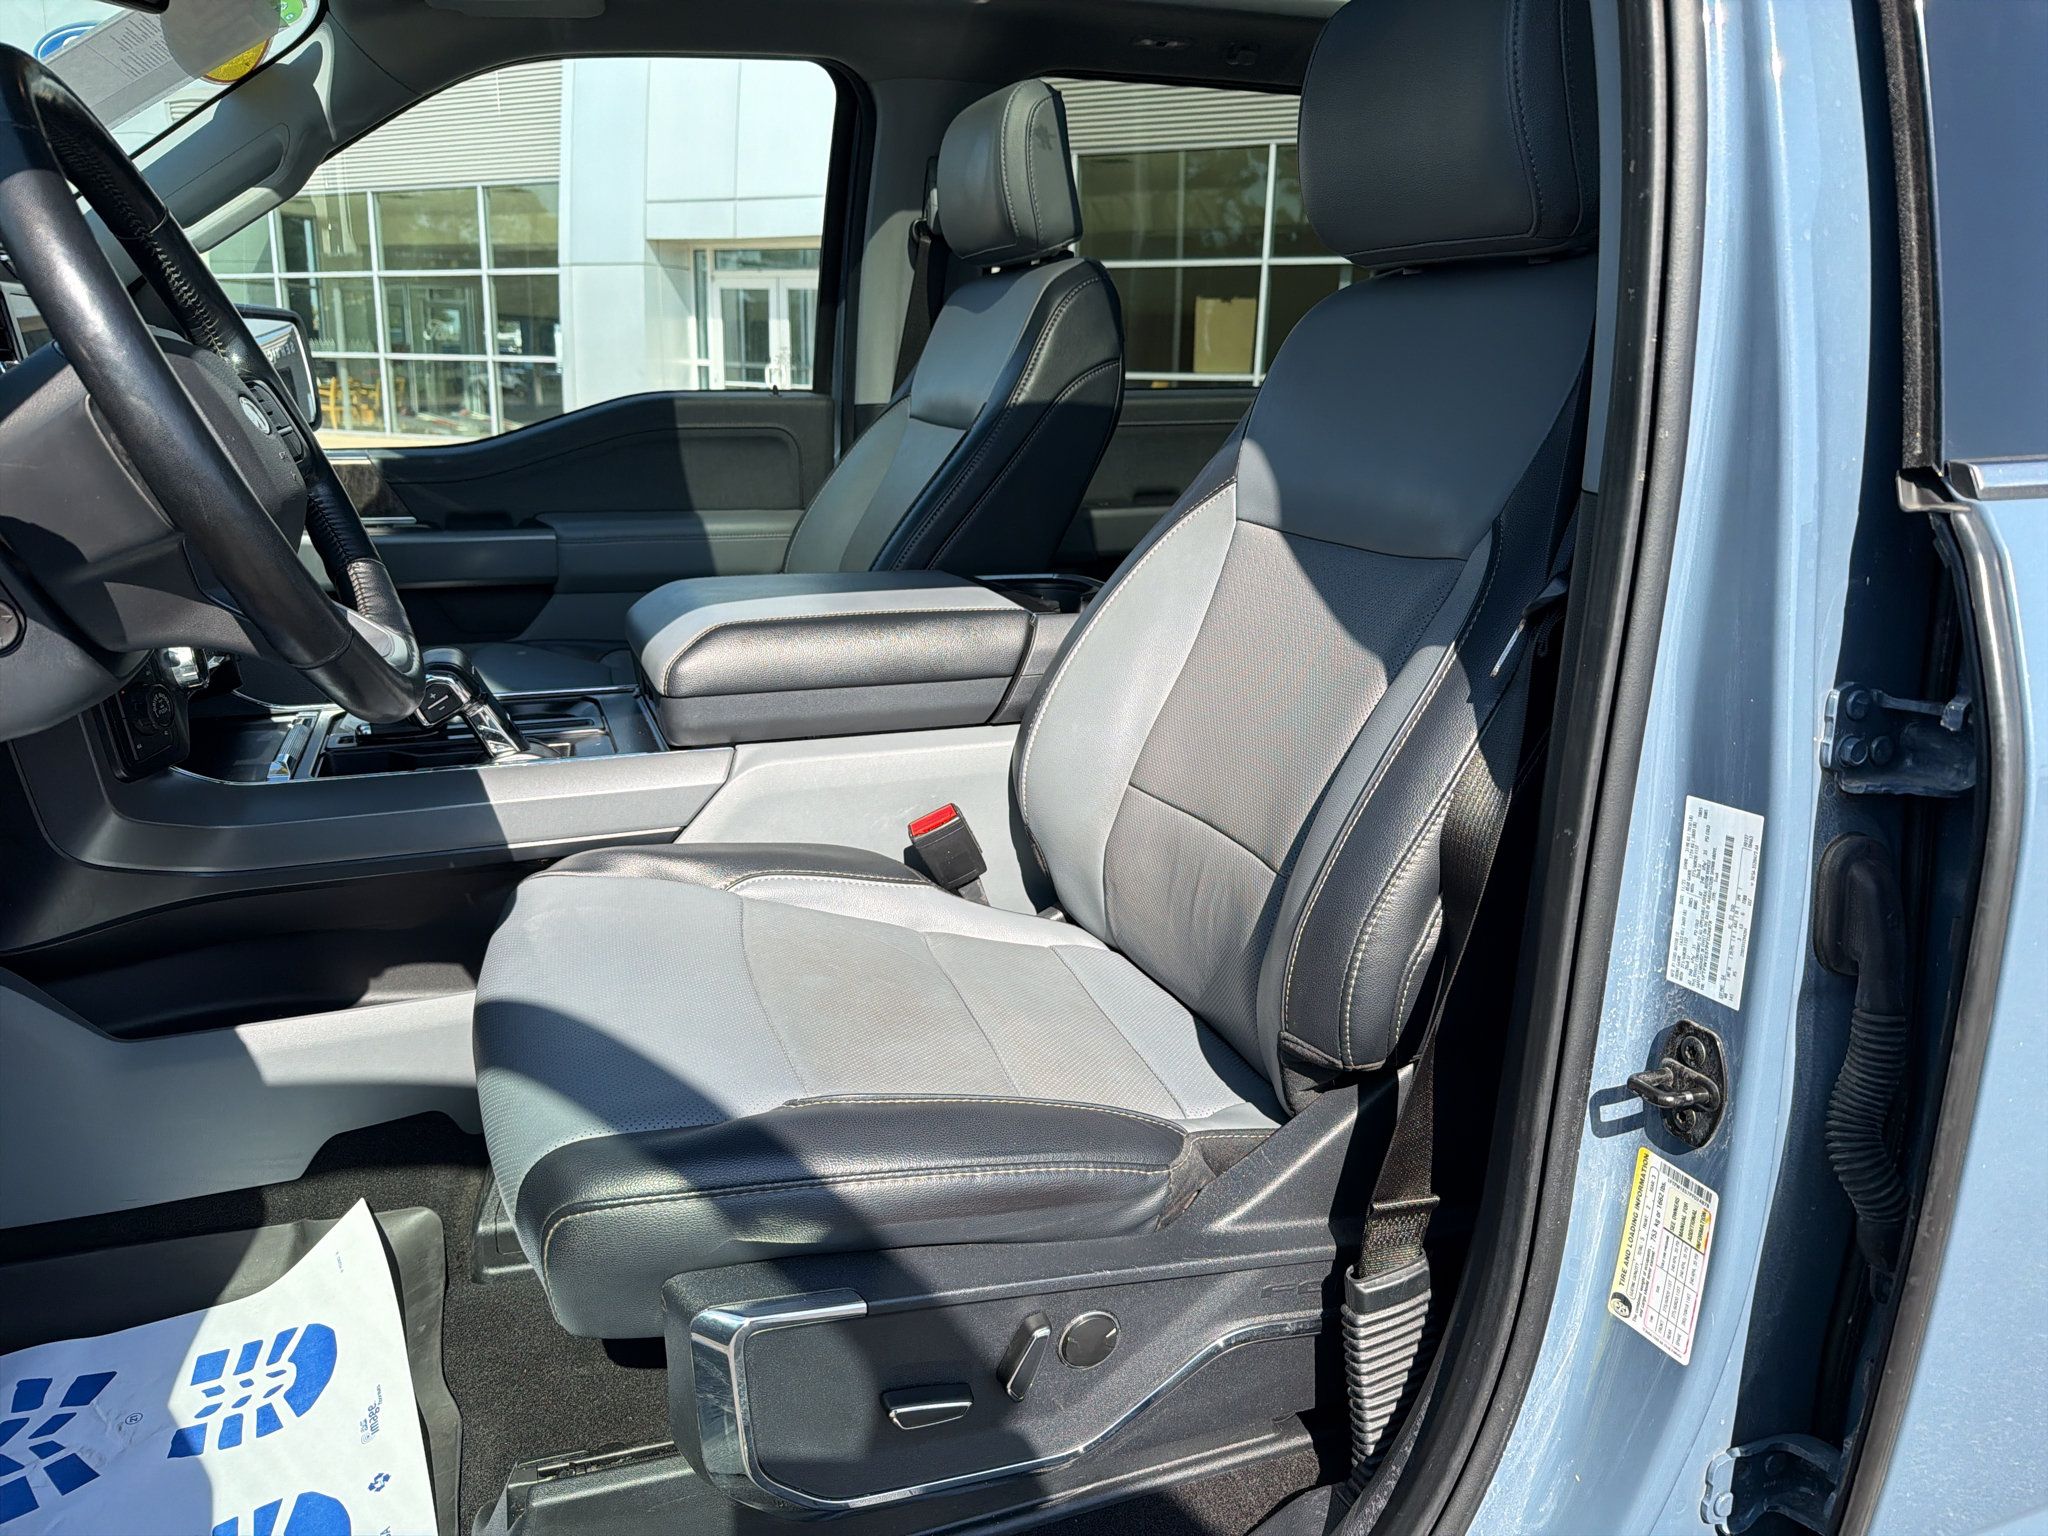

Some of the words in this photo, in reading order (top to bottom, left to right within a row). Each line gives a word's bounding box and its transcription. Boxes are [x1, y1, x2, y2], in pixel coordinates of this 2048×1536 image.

[1633, 1151, 1650, 1210] INFORMATION
[1656, 1191, 1664, 1209] 1662
[1670, 1195, 1680, 1221] OWNERS
[1626, 1210, 1638, 1249] LOADING
[1677, 1213, 1686, 1237] MANUAL
[1686, 1207, 1697, 1242] ADDITIONAL
[1694, 1209, 1707, 1249] INFORMATION
[1622, 1247, 1631, 1267] AND
[1618, 1266, 1627, 1288] TIRE
